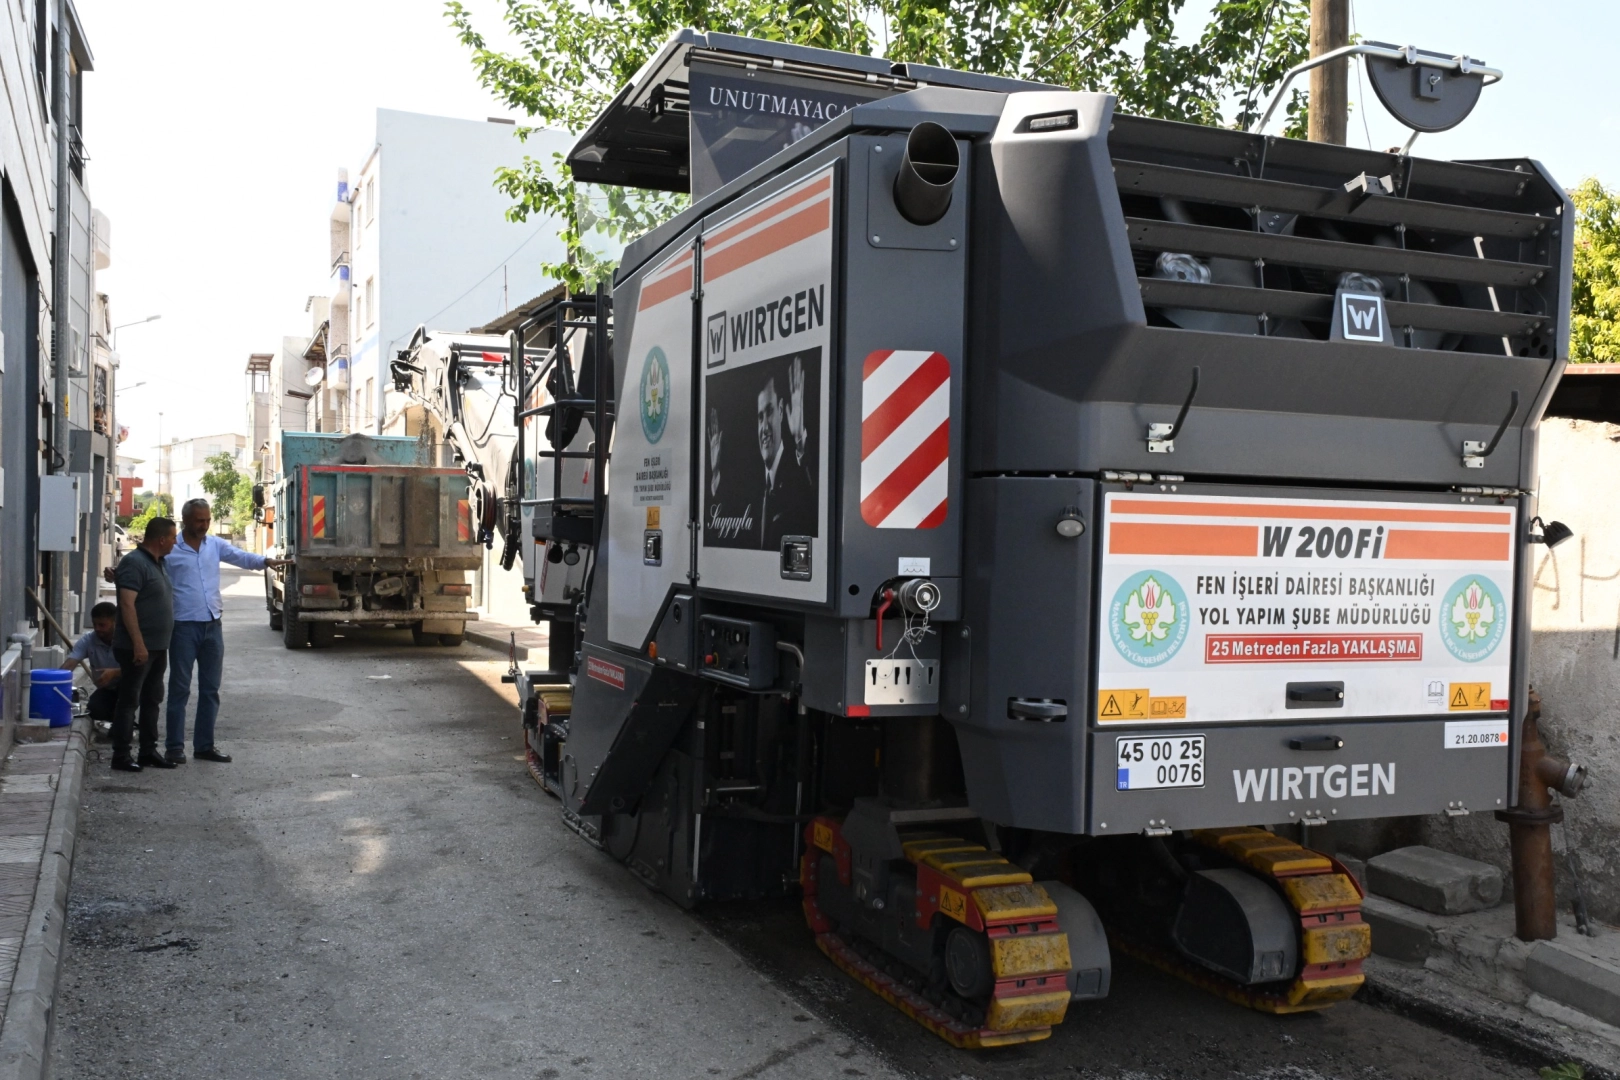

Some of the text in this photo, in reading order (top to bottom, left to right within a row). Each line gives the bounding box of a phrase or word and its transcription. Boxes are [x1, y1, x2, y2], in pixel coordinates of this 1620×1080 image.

[709, 86, 863, 121] UNUTMAYACA
[730, 284, 825, 353] WIRTGEN
[1347, 304, 1376, 330] W
[707, 502, 753, 539] Saygıyla
[1196, 571, 1435, 600] FEN İŞLERİ DAİRESİ BAŞKANLIĞI
[1199, 603, 1432, 629] YOL YAPIM ŞUBE MÜDÜRLÜĞÜ
[1211, 639, 1417, 658] 25 Metreden Fazla YAKLAŞMA
[1119, 740, 1202, 762] 45 00 25
[1455, 733, 1500, 745] 21.20.0878
[1157, 763, 1202, 784] 0076
[1232, 762, 1396, 804] WIRTGEN
